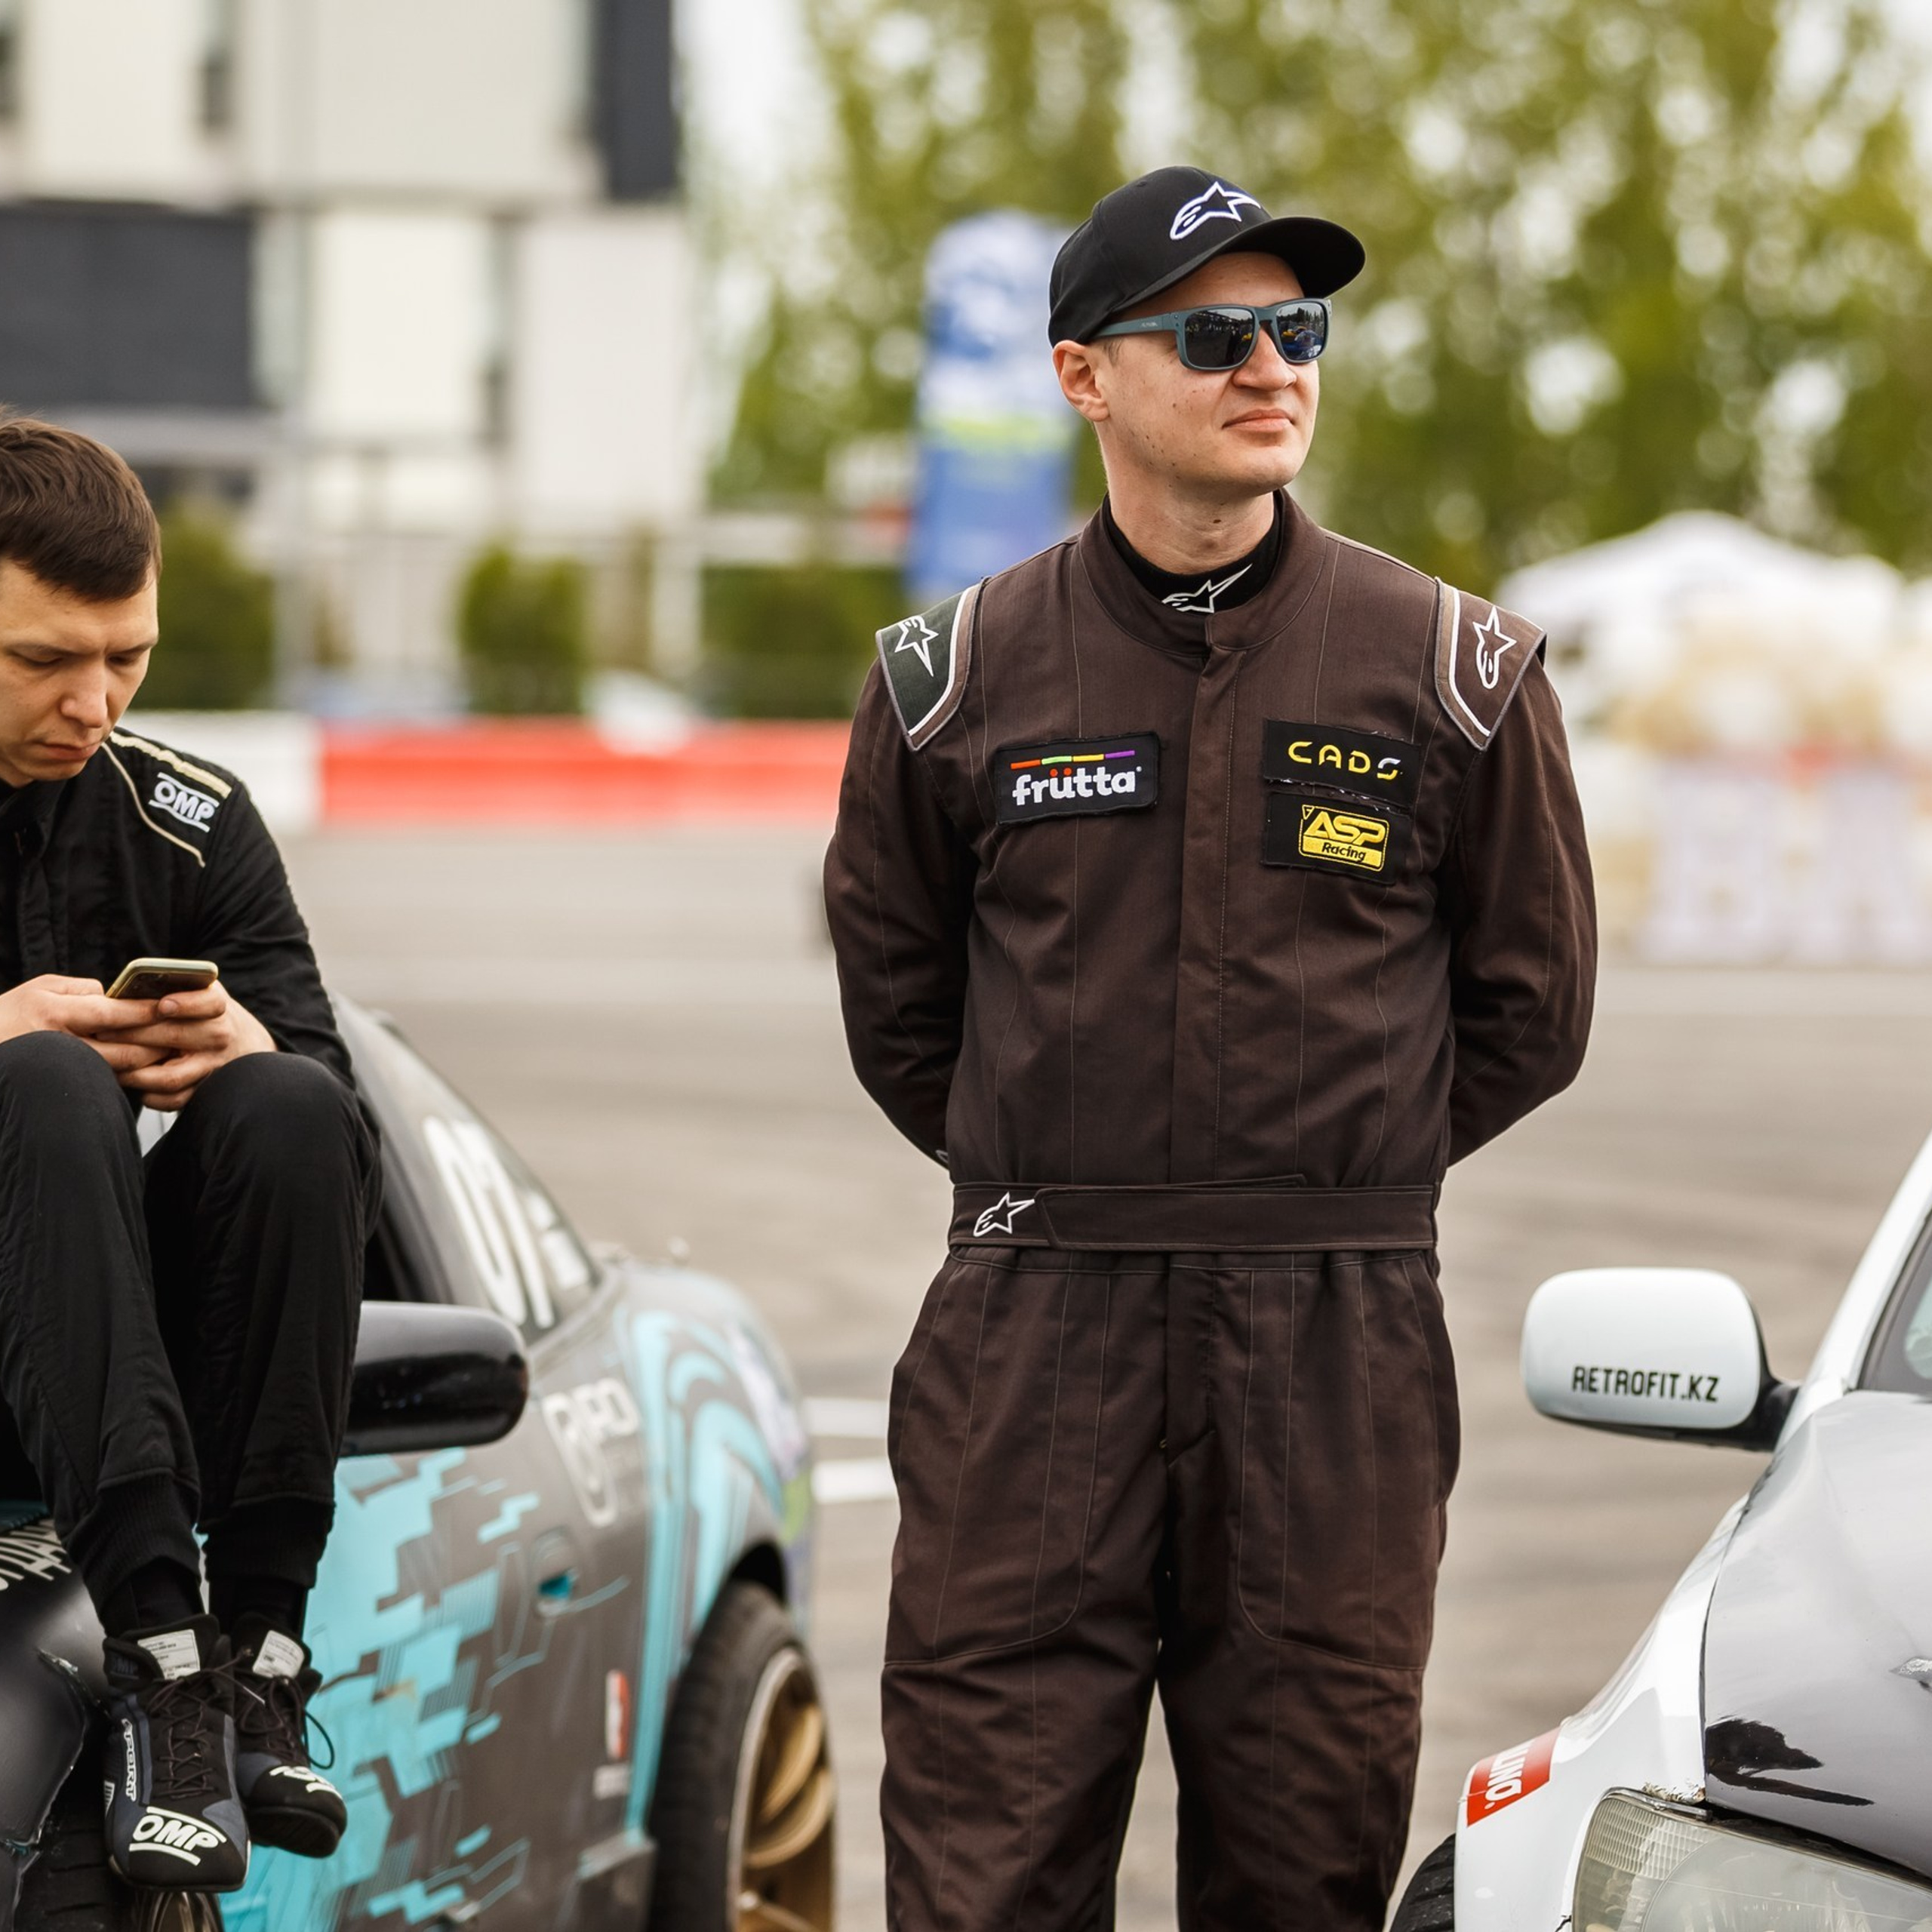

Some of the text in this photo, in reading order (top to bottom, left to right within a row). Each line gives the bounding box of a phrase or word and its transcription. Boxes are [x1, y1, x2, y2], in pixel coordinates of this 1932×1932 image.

[1288, 741, 1401, 780] CADS
[154, 780, 215, 821] OMP
[1012, 766, 1136, 806] frütta
[1303, 811, 1386, 846] ASP
[1321, 841, 1367, 862] Racing
[1572, 1366, 1719, 1403] RETROFIT.KZ
[132, 1814, 220, 1852] OMP
